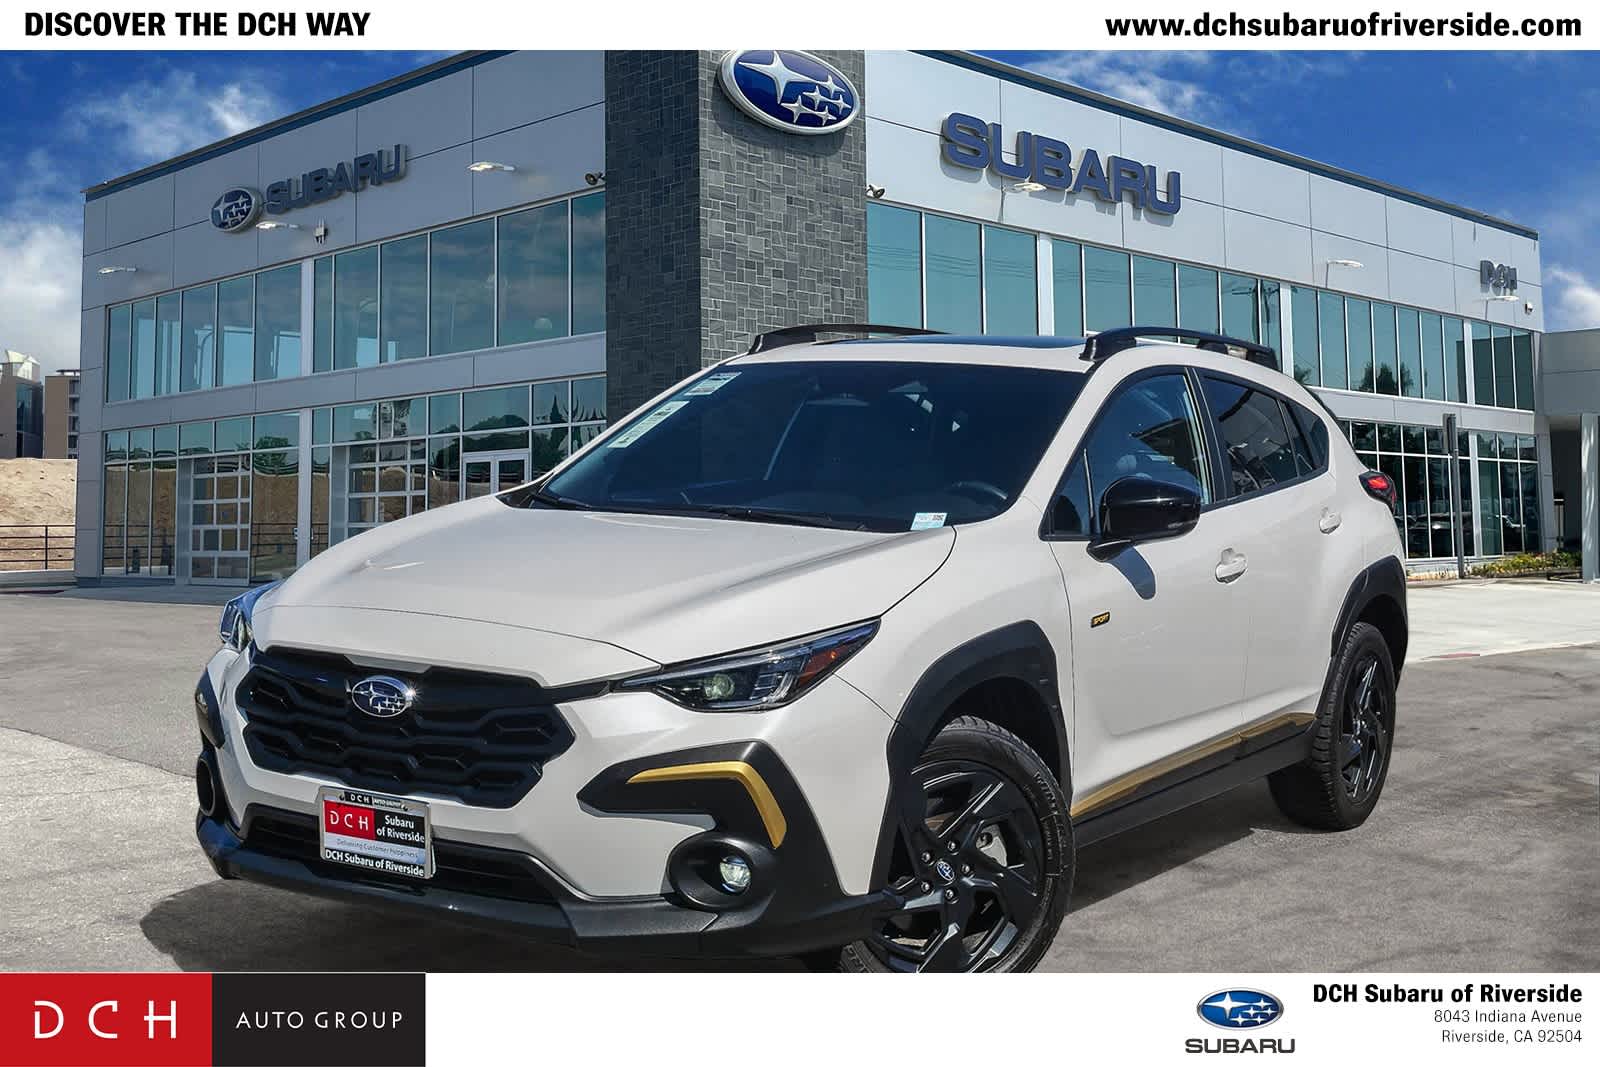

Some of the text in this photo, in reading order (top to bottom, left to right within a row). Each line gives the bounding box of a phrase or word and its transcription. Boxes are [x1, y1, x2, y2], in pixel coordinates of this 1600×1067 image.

[942, 112, 1181, 216] SUBARU
[266, 144, 407, 215] SUBARU
[350, 793, 370, 804] DCH
[329, 810, 369, 831] DCH
[384, 814, 414, 829] Subaru
[376, 826, 425, 843] of Riverside
[325, 849, 424, 877] DCH Subaru of Riverside
